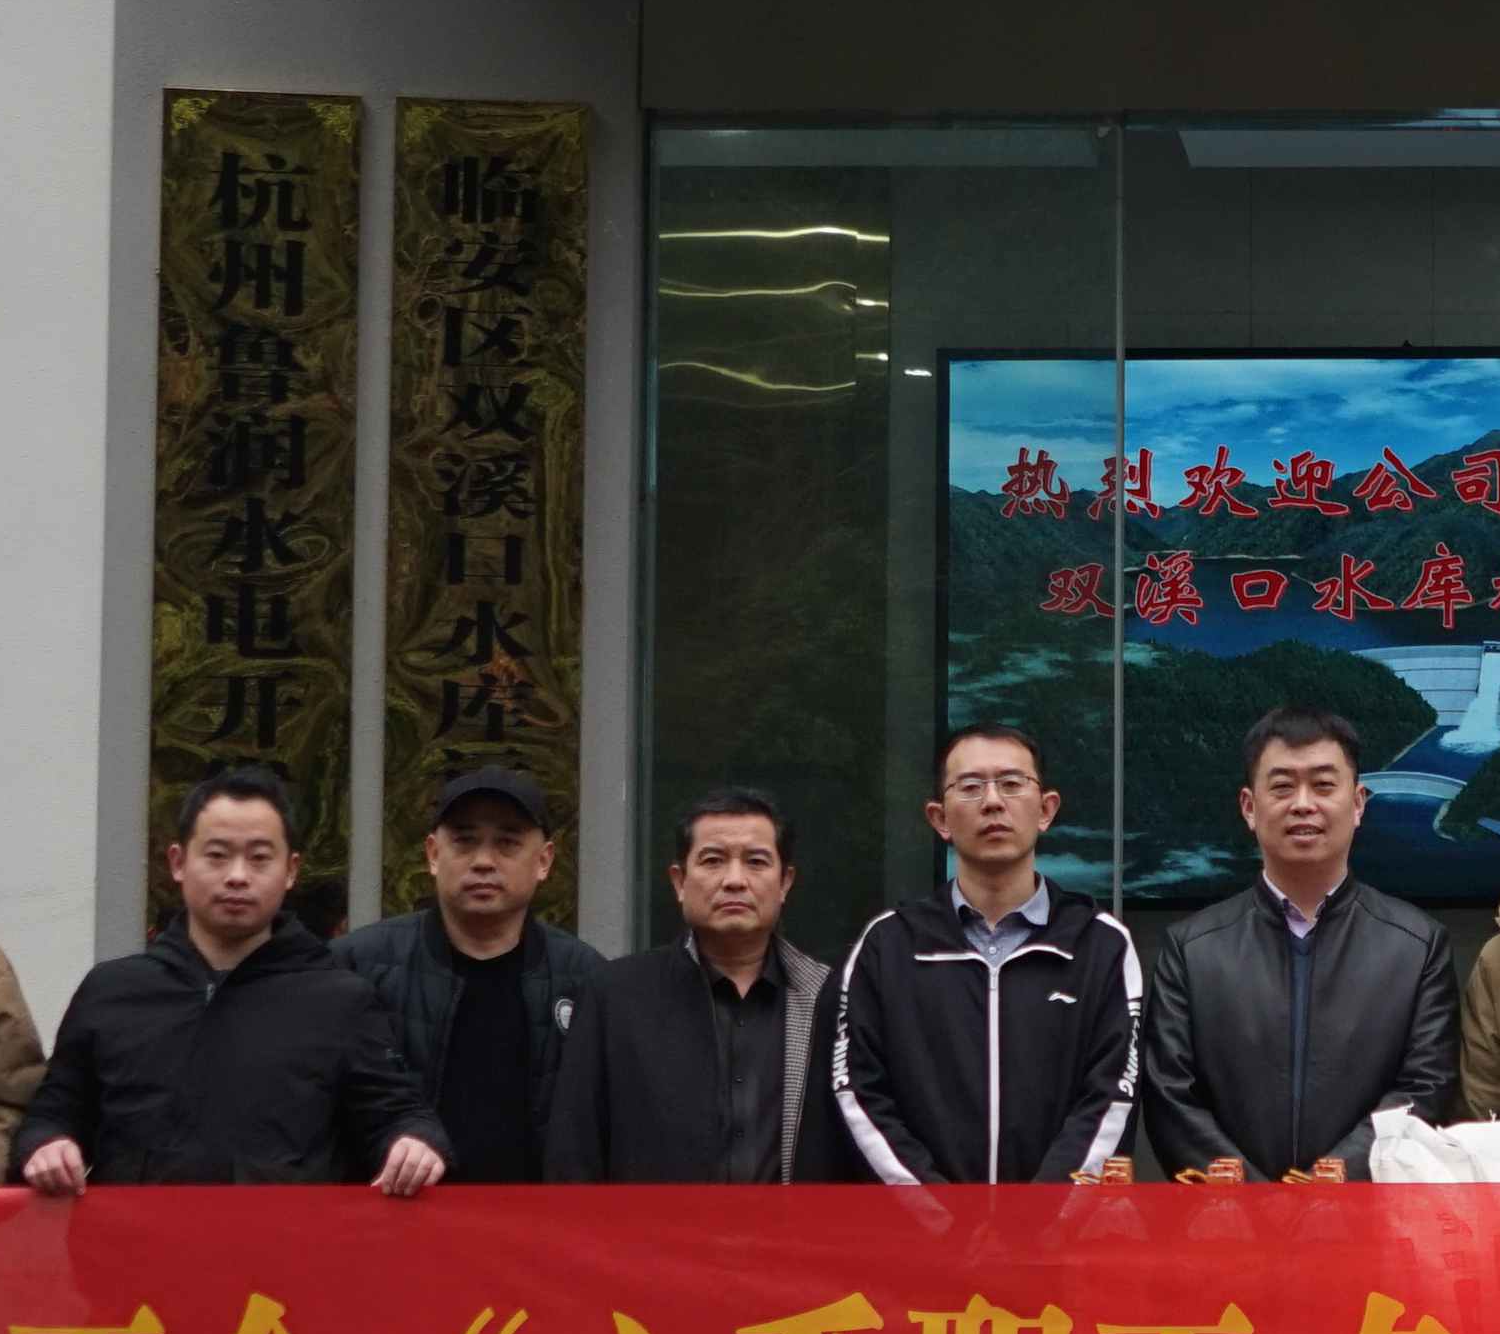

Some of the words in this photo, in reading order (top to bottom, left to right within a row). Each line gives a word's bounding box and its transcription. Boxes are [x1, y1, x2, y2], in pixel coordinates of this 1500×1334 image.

[203, 150, 313, 779] 杭州鲁润水电开
[433, 156, 538, 769] 临安区双溪口水库
